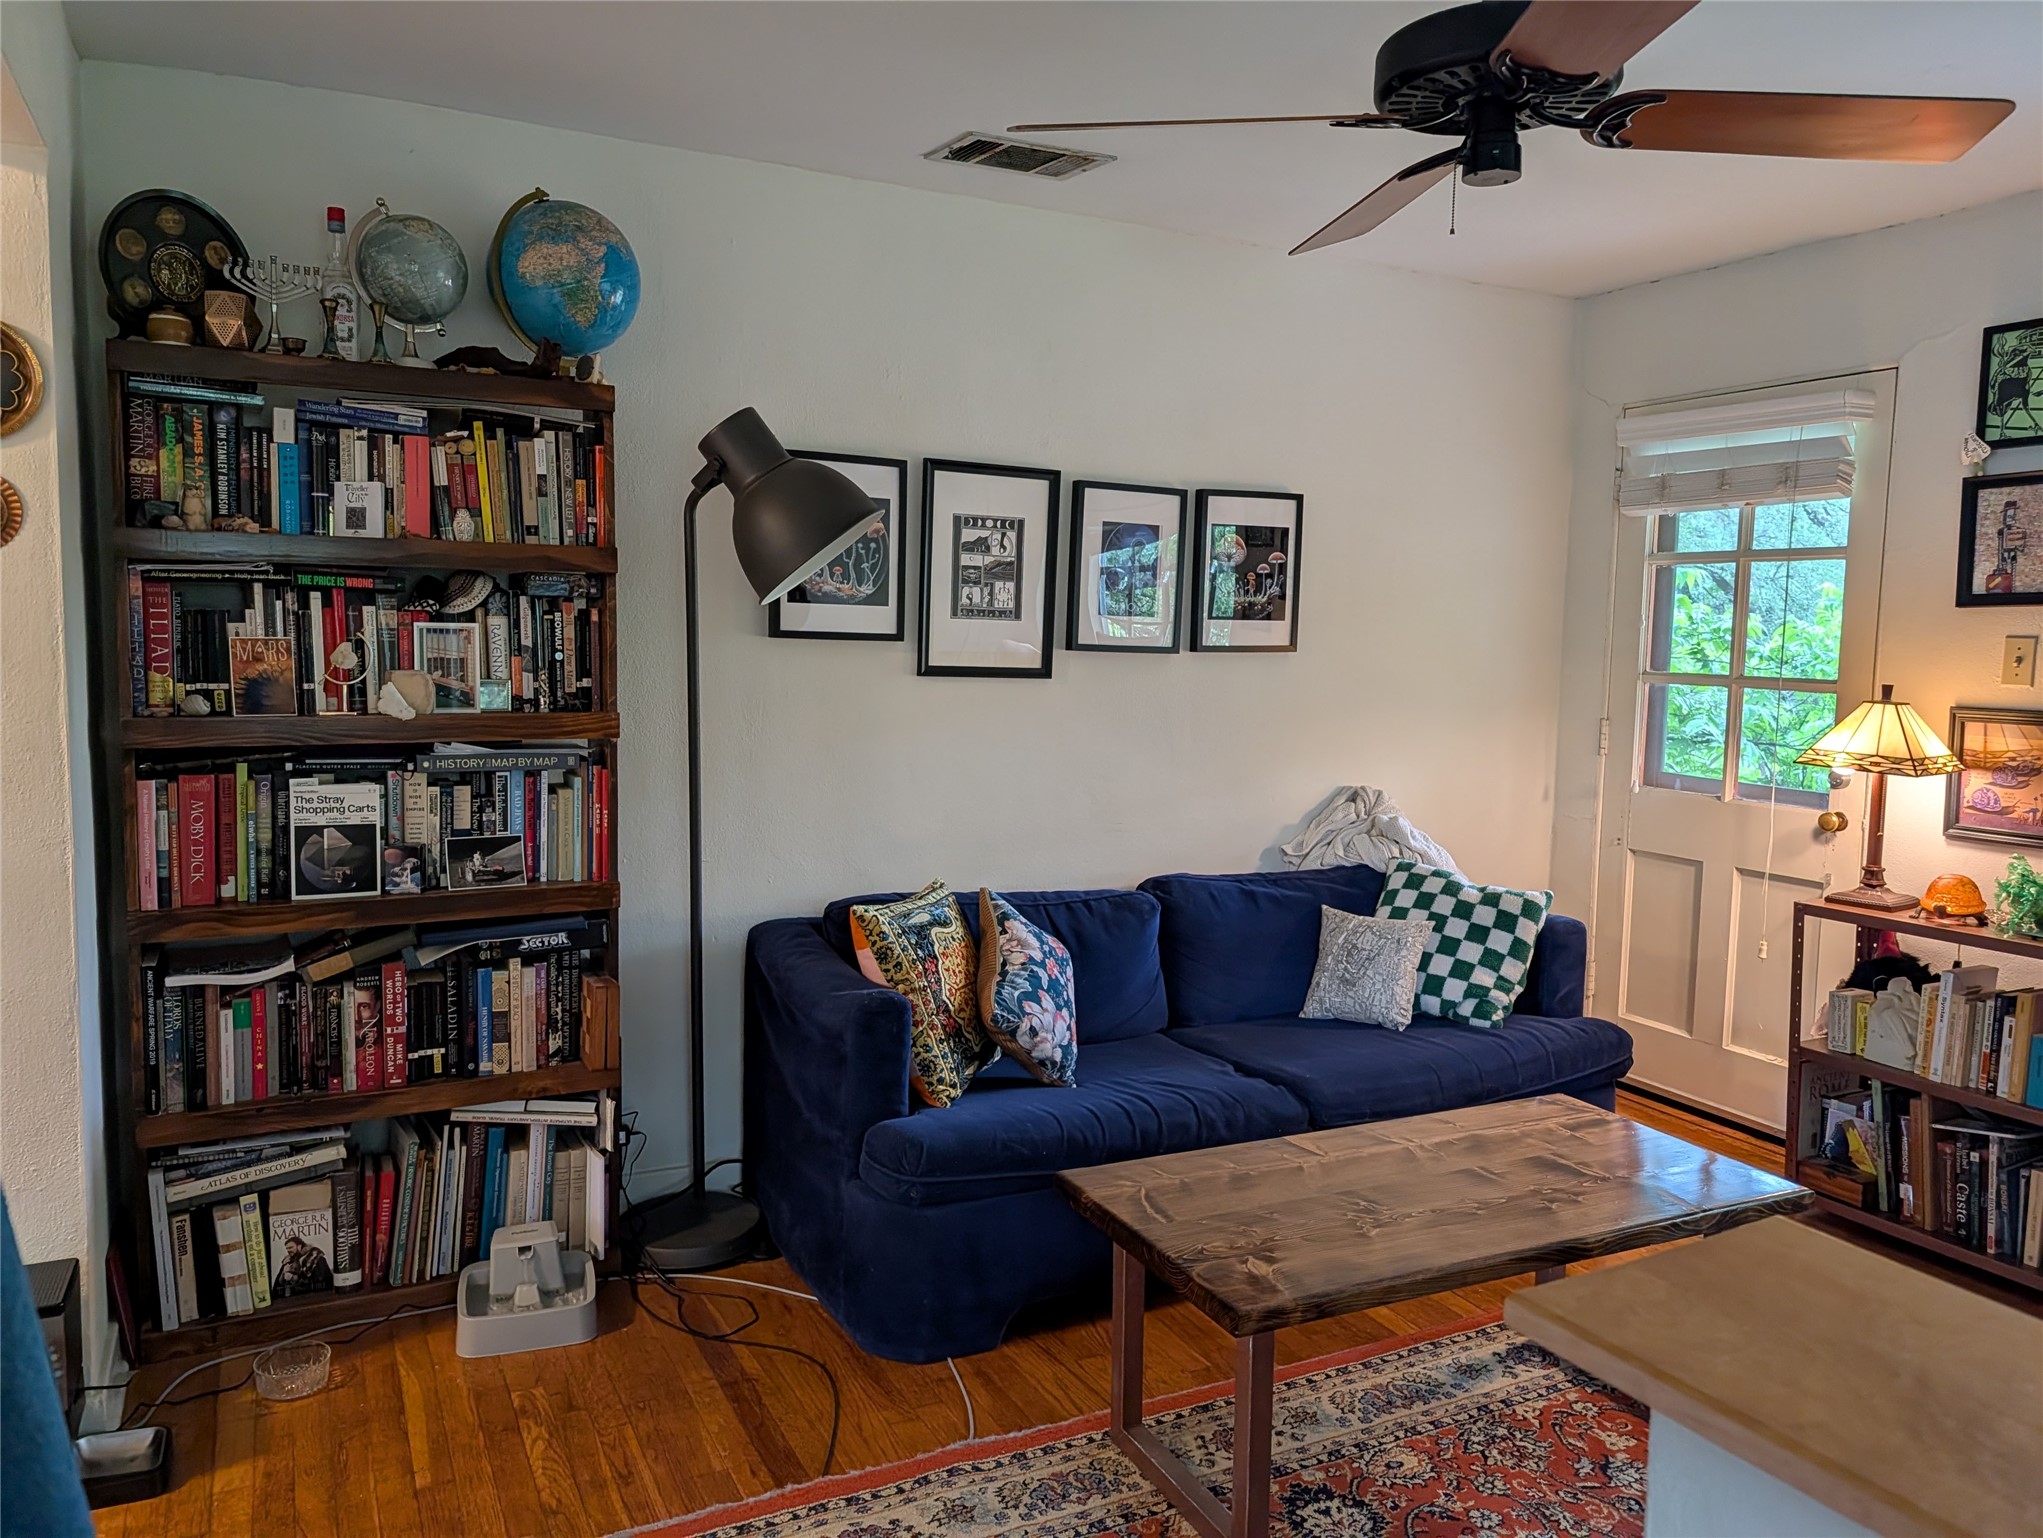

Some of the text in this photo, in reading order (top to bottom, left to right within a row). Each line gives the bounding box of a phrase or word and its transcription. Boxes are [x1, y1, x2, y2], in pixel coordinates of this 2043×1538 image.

[144, 398, 153, 435] GEORGE
[304, 401, 339, 414] Wandering
[340, 405, 355, 415] Stars
[305, 411, 325, 420] Jewish
[130, 397, 143, 457] MARTIN
[192, 416, 204, 454] JAMES
[195, 456, 204, 466] S.
[195, 468, 204, 479] A.
[216, 424, 229, 515] KIM STANLEY ROBINSON
[229, 430, 238, 515] MINISTRY FUTURE
[143, 477, 153, 500] FIRE
[563, 448, 574, 523] HISTORY NEW LEFT
[151, 570, 168, 578] After
[170, 571, 222, 580] Geoengineering
[234, 572, 251, 580] Holly
[297, 574, 374, 588] THE PRICE IS WRONG
[531, 575, 565, 583] CASCADIA
[174, 596, 182, 616] PLATO
[522, 607, 531, 640] Gilgamesh
[555, 612, 563, 650] BEOWULF
[149, 607, 171, 676] ILIAD
[236, 640, 288, 663] MARS
[490, 623, 503, 680] RAVENNA
[436, 756, 559, 769] HISTORY MAP BY MAP
[277, 790, 288, 826] Otherlands
[293, 804, 377, 816] Shopping Carts
[294, 795, 345, 806] The Stray
[391, 779, 400, 817] Shutdown
[472, 797, 481, 813] The
[497, 775, 506, 831] The Holocaust
[190, 801, 205, 841] MOBY
[258, 781, 270, 883] Origin Jennifer Raff
[472, 813, 480, 830] New
[514, 808, 522, 831] JEWS
[190, 846, 205, 885] DICK
[518, 931, 572, 952] SECTOR
[550, 953, 558, 963] The
[549, 962, 558, 984] Galleys
[571, 951, 579, 1014] THE DISCOVERY
[172, 996, 183, 1030] LORDS
[300, 986, 308, 1006] BLOOD
[385, 979, 394, 1016] WORLDS
[394, 970, 403, 1023] HERO OF TWO
[447, 979, 458, 1040] SALADIN
[562, 951, 570, 1057] AND CONQUEST OF MEXICO
[1939, 996, 1948, 1023] Syntax
[147, 970, 157, 1066] ANCIENT WARFARE SPRING 2019
[163, 996, 174, 1041] OF ITALY
[193, 998, 206, 1070] BURNED ALIVE
[359, 1013, 380, 1075] NAPOLEON
[386, 1036, 395, 1073] DUNCAN
[395, 1043, 403, 1065] MIKE
[472, 1125, 481, 1157] MARTIN
[1901, 1135, 1909, 1174] MISSIONS
[200, 1154, 314, 1192] ATLAS OF DISCOVERY
[545, 1172, 553, 1184] City
[1956, 1182, 1970, 1223] Caste
[2000, 1184, 2008, 1213] BONSAI
[175, 1218, 188, 1257] Fanshen
[272, 1216, 310, 1229] GEORGE
[272, 1222, 329, 1242] MARTIN
[347, 1225, 359, 1247] THE
